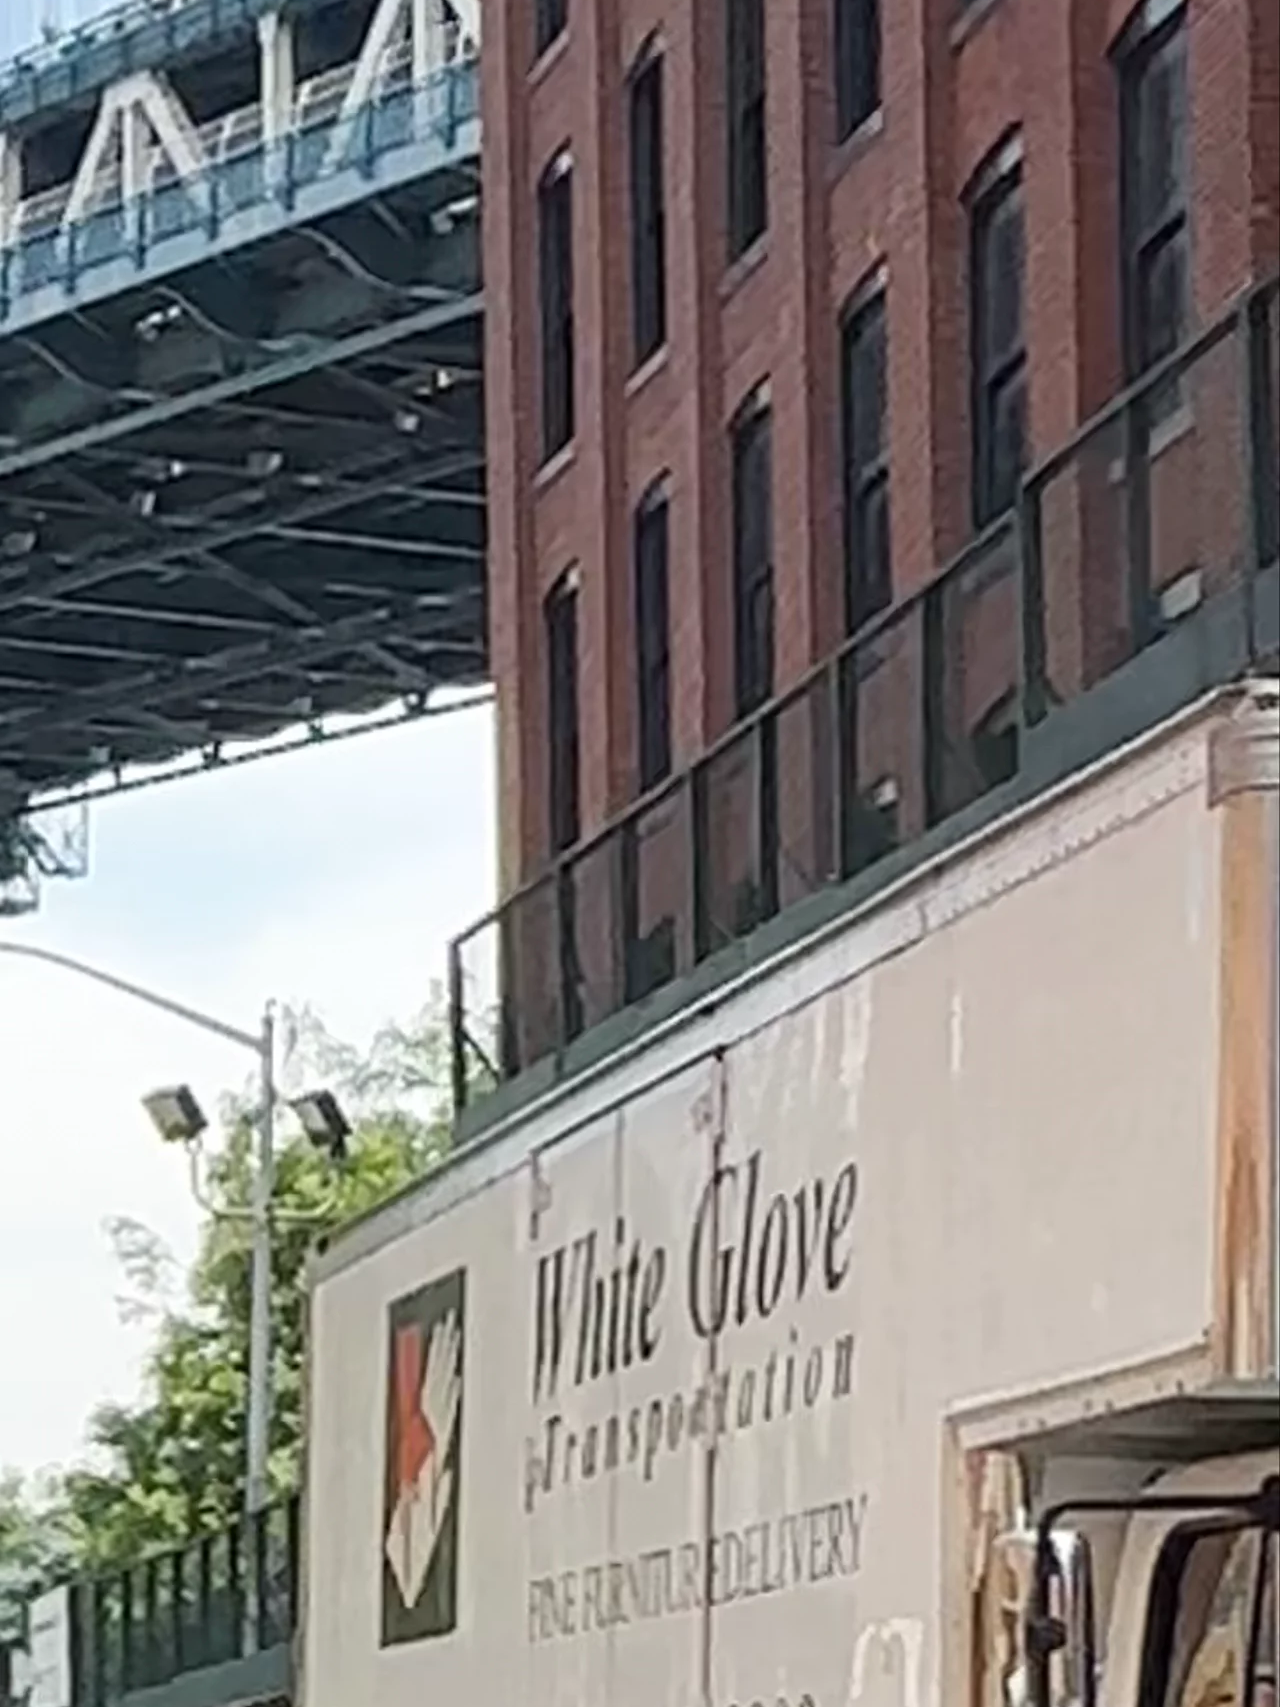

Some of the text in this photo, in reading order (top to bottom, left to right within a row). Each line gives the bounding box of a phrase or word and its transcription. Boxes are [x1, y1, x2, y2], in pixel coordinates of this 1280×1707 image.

[532, 1148, 856, 1406] White Glove
[543, 1326, 854, 1493] Transportation
[528, 1570, 576, 1643] FINE
[723, 1493, 867, 1605] DELIVERY
